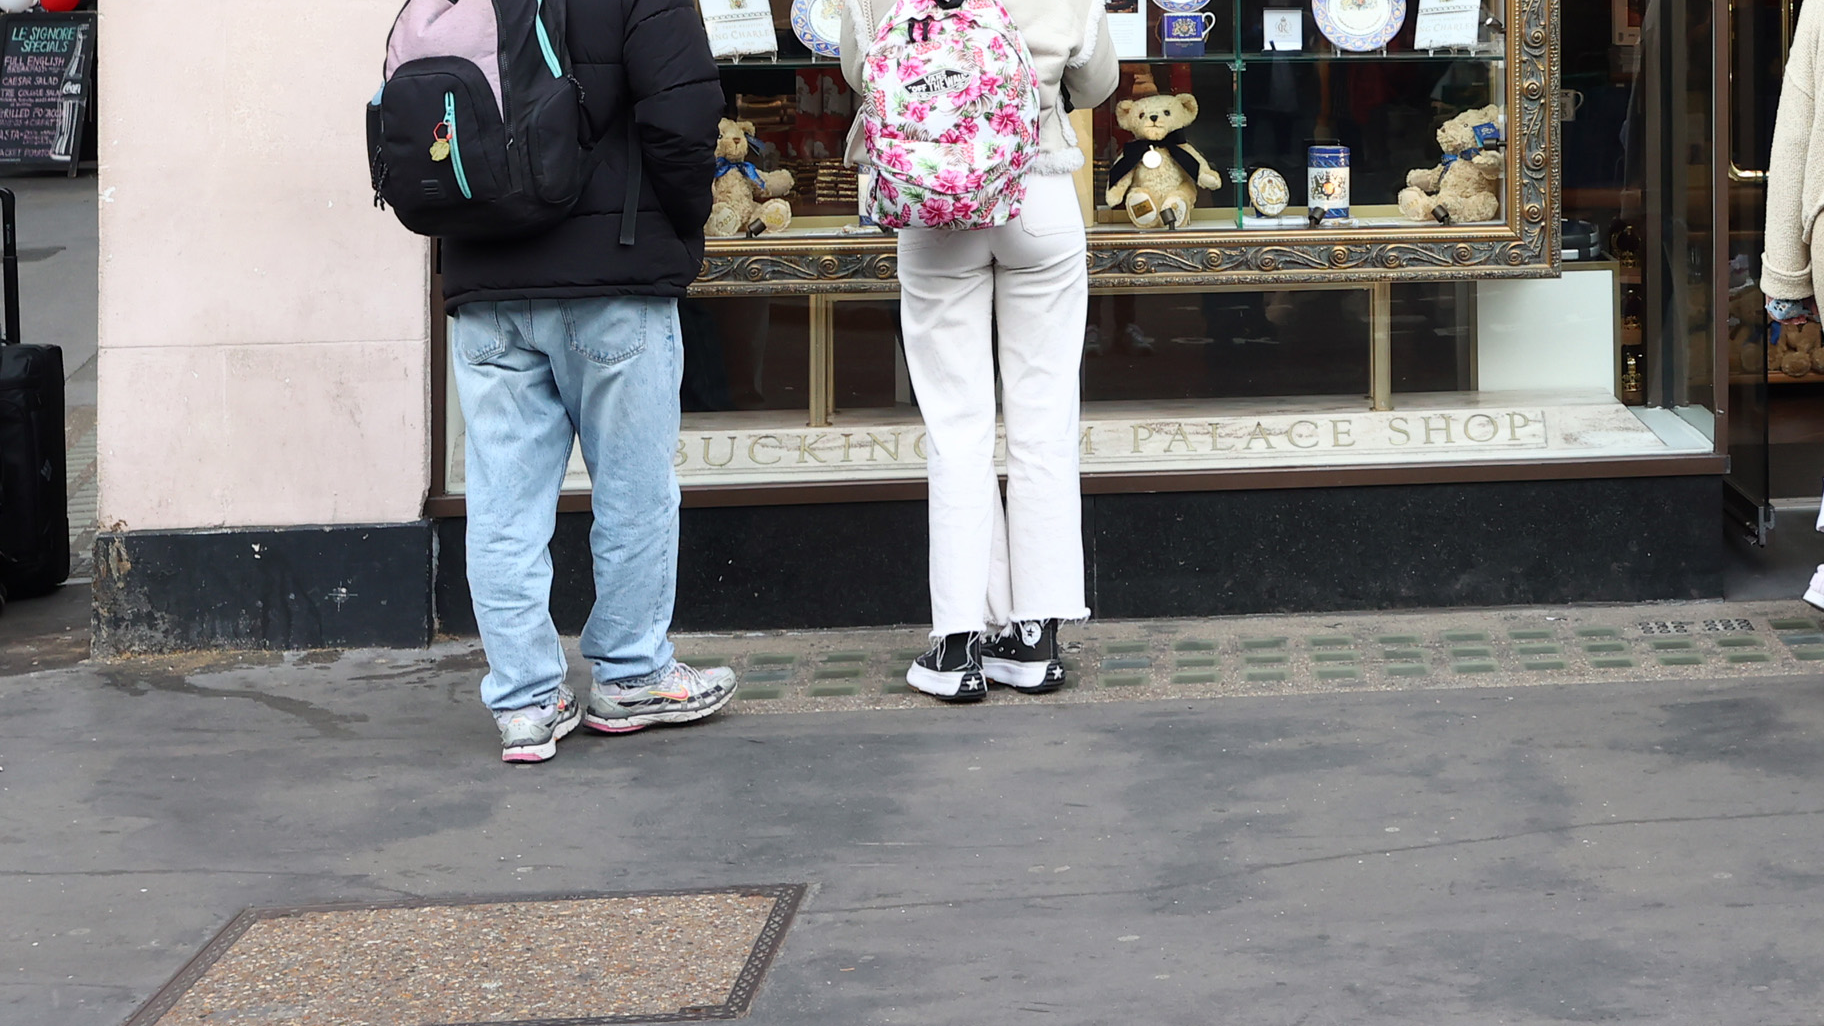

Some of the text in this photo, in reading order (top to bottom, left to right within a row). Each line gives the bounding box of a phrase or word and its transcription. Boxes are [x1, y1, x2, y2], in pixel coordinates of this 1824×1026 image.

[30, 26, 76, 41] SIGNORE
[21, 40, 69, 53] SPECIALS
[923, 72, 947, 84] VANS
[928, 79, 946, 92] THE
[1130, 420, 1356, 454] PALACE
[1389, 412, 1530, 446] SHOP
